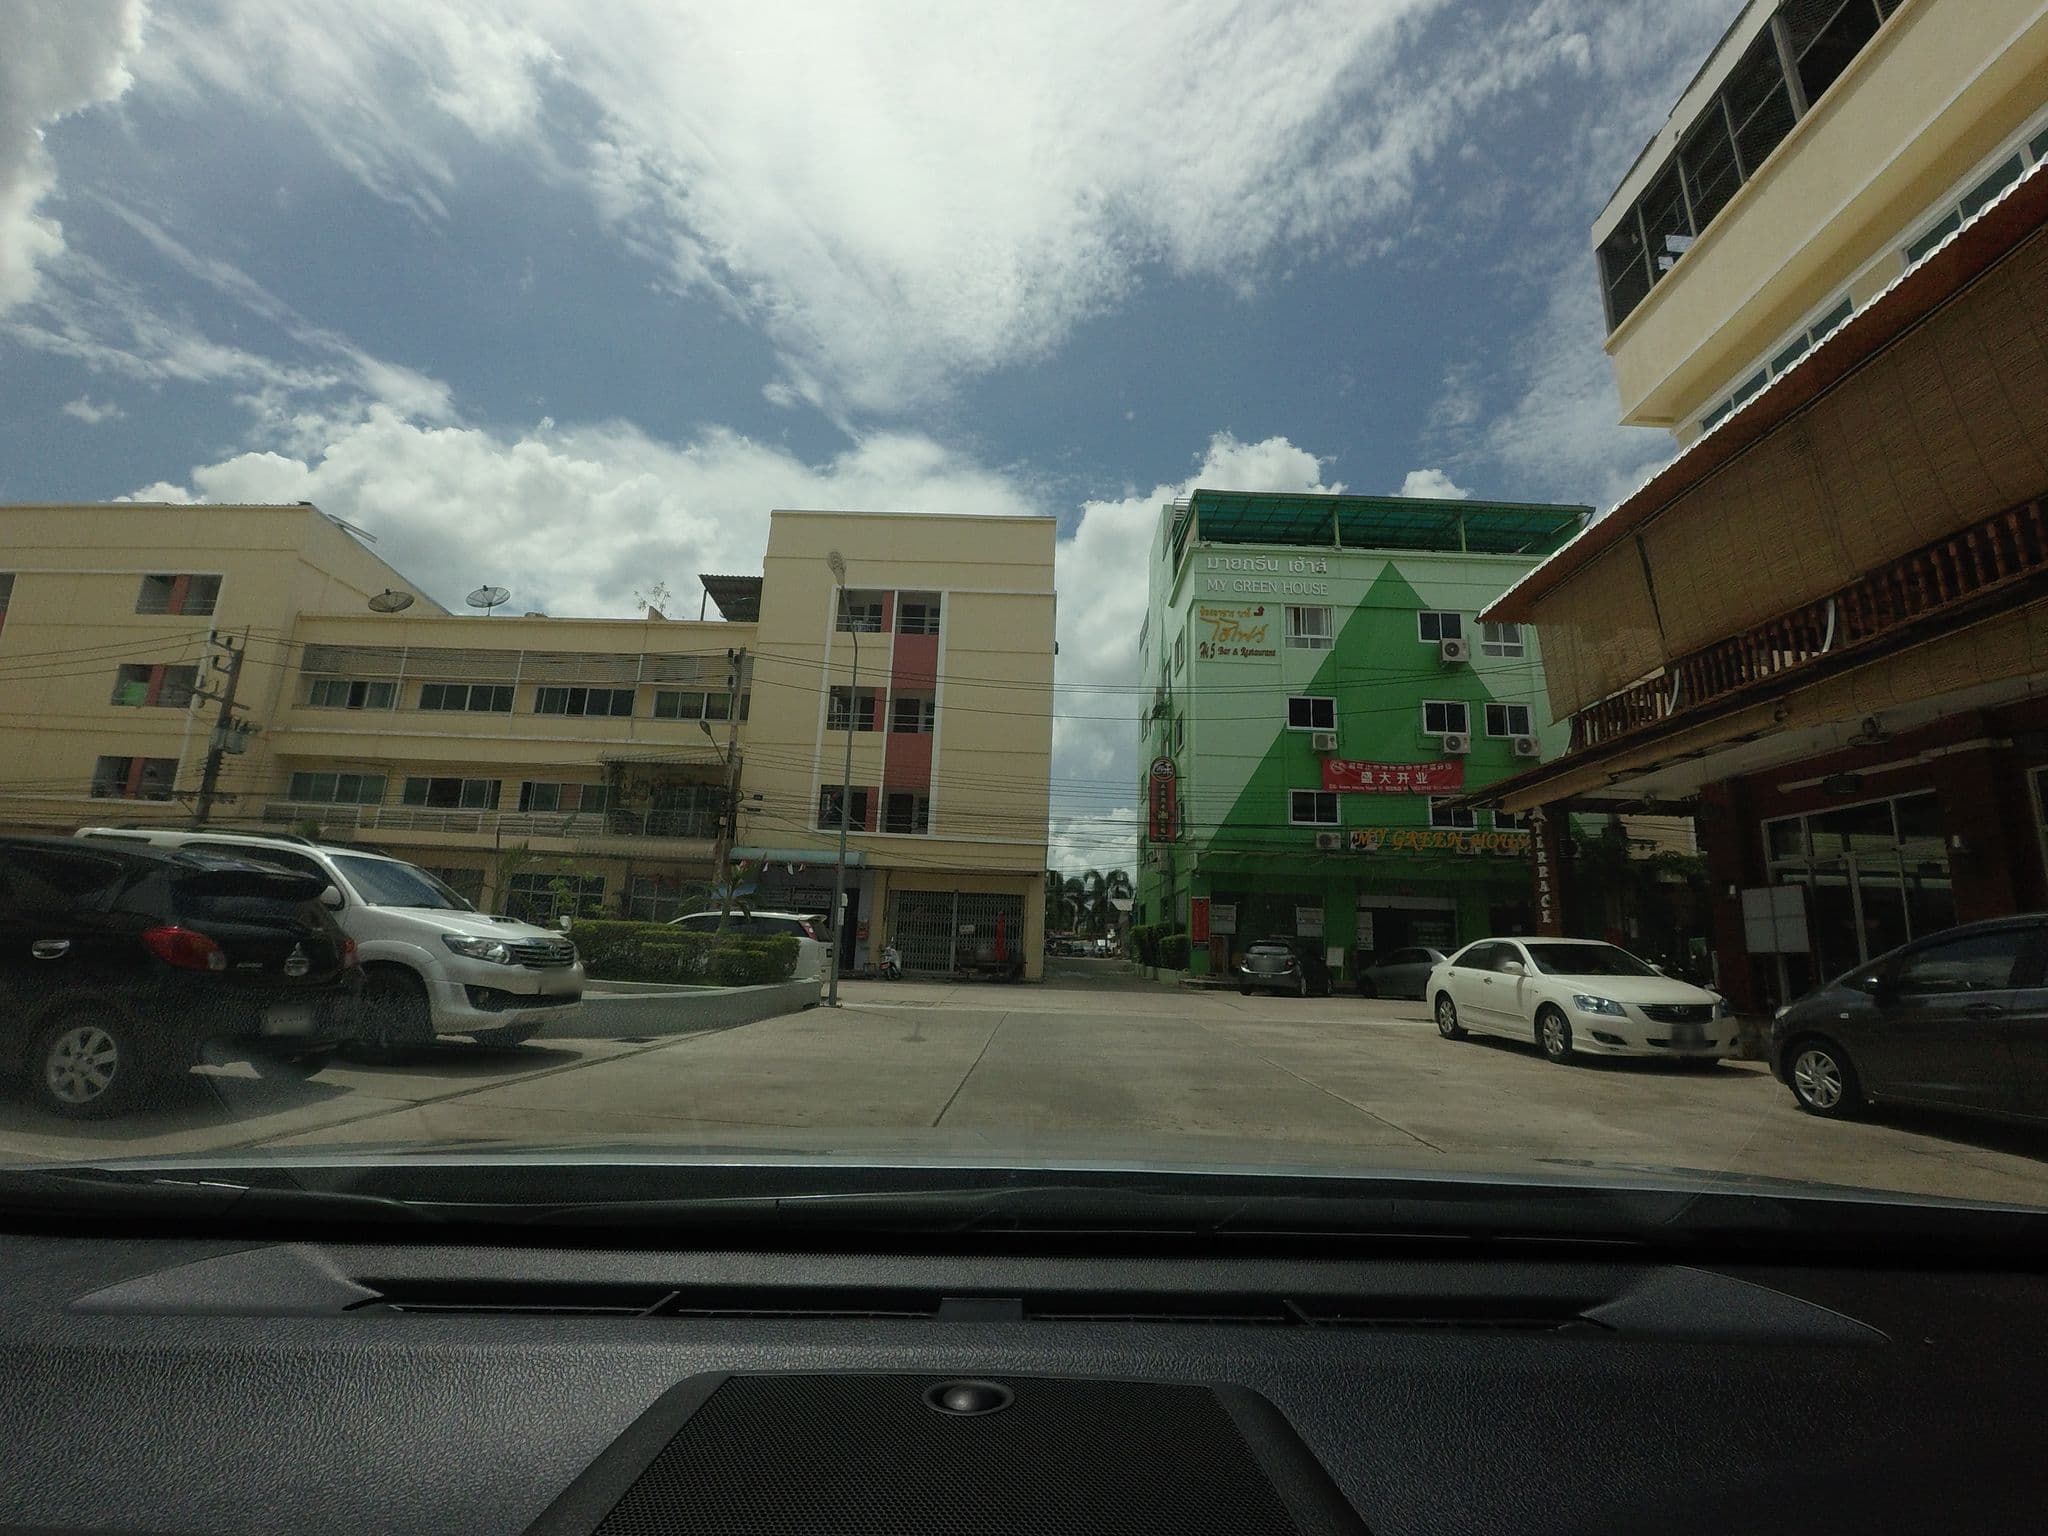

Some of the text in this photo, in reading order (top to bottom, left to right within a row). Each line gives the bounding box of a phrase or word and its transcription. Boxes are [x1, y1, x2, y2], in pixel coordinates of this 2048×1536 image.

[1207, 578, 1328, 596] MY GREEN HOUSE
[1360, 771, 1428, 785] 盛大开业
[1391, 831, 1465, 851] GREEN
